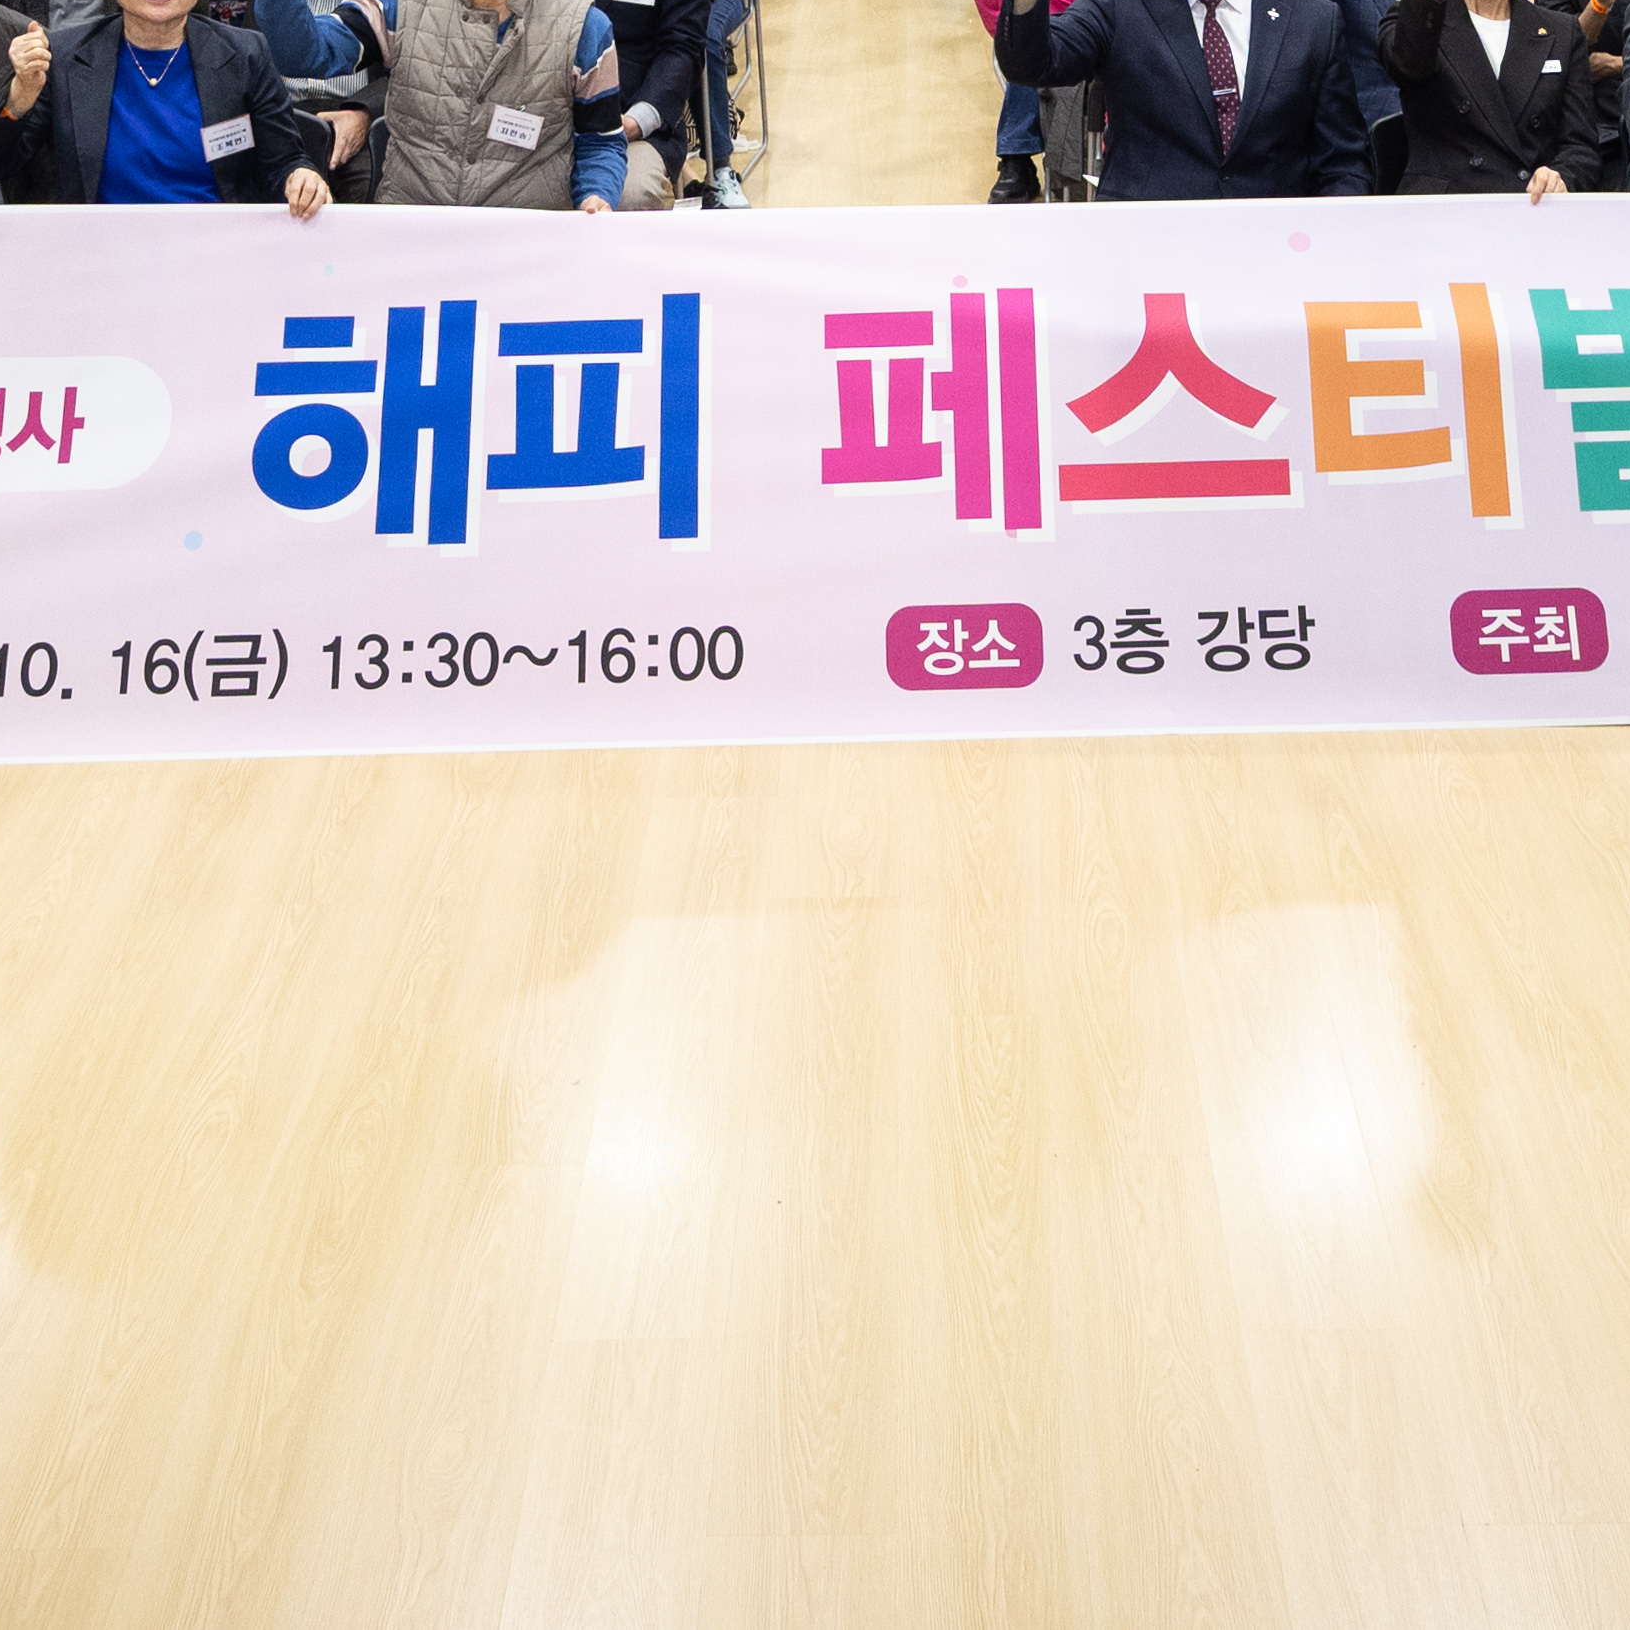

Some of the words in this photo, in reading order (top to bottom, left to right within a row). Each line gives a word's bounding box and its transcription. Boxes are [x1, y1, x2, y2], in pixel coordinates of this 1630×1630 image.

[253, 293, 699, 544] 해피
[112, 629, 288, 701] 16(금)
[323, 626, 743, 690] 13:30~16:00
[917, 619, 1020, 675] 장소
[1074, 609, 1169, 674] 3층
[1197, 605, 1315, 672] 강당
[1479, 606, 1580, 662] 주최
